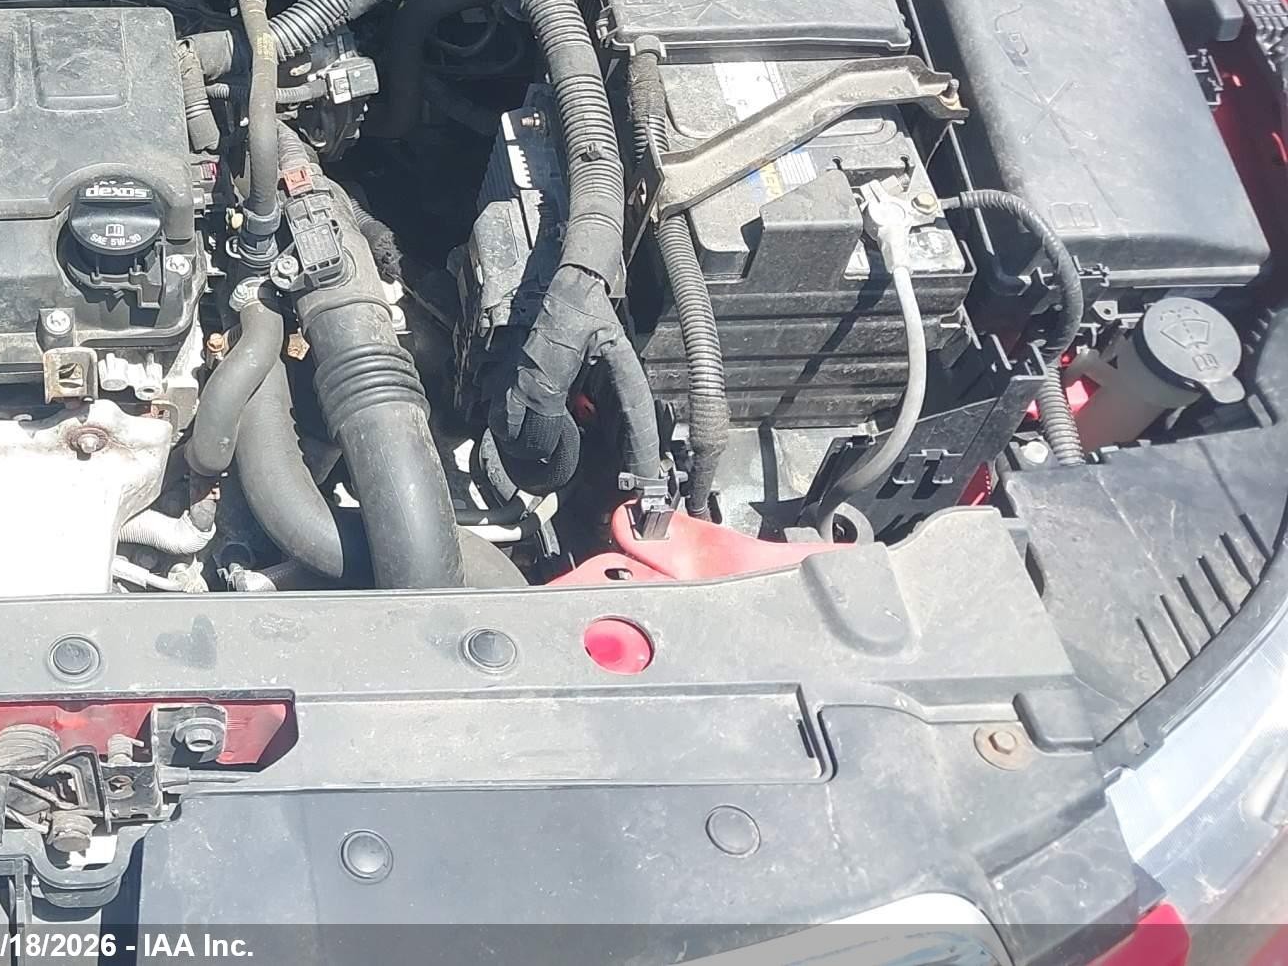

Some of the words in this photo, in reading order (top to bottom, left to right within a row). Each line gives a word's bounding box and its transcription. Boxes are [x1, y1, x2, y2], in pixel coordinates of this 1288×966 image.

[85, 184, 148, 198] dexos
[90, 234, 107, 245] SAE
[111, 234, 142, 246] 5W-30
